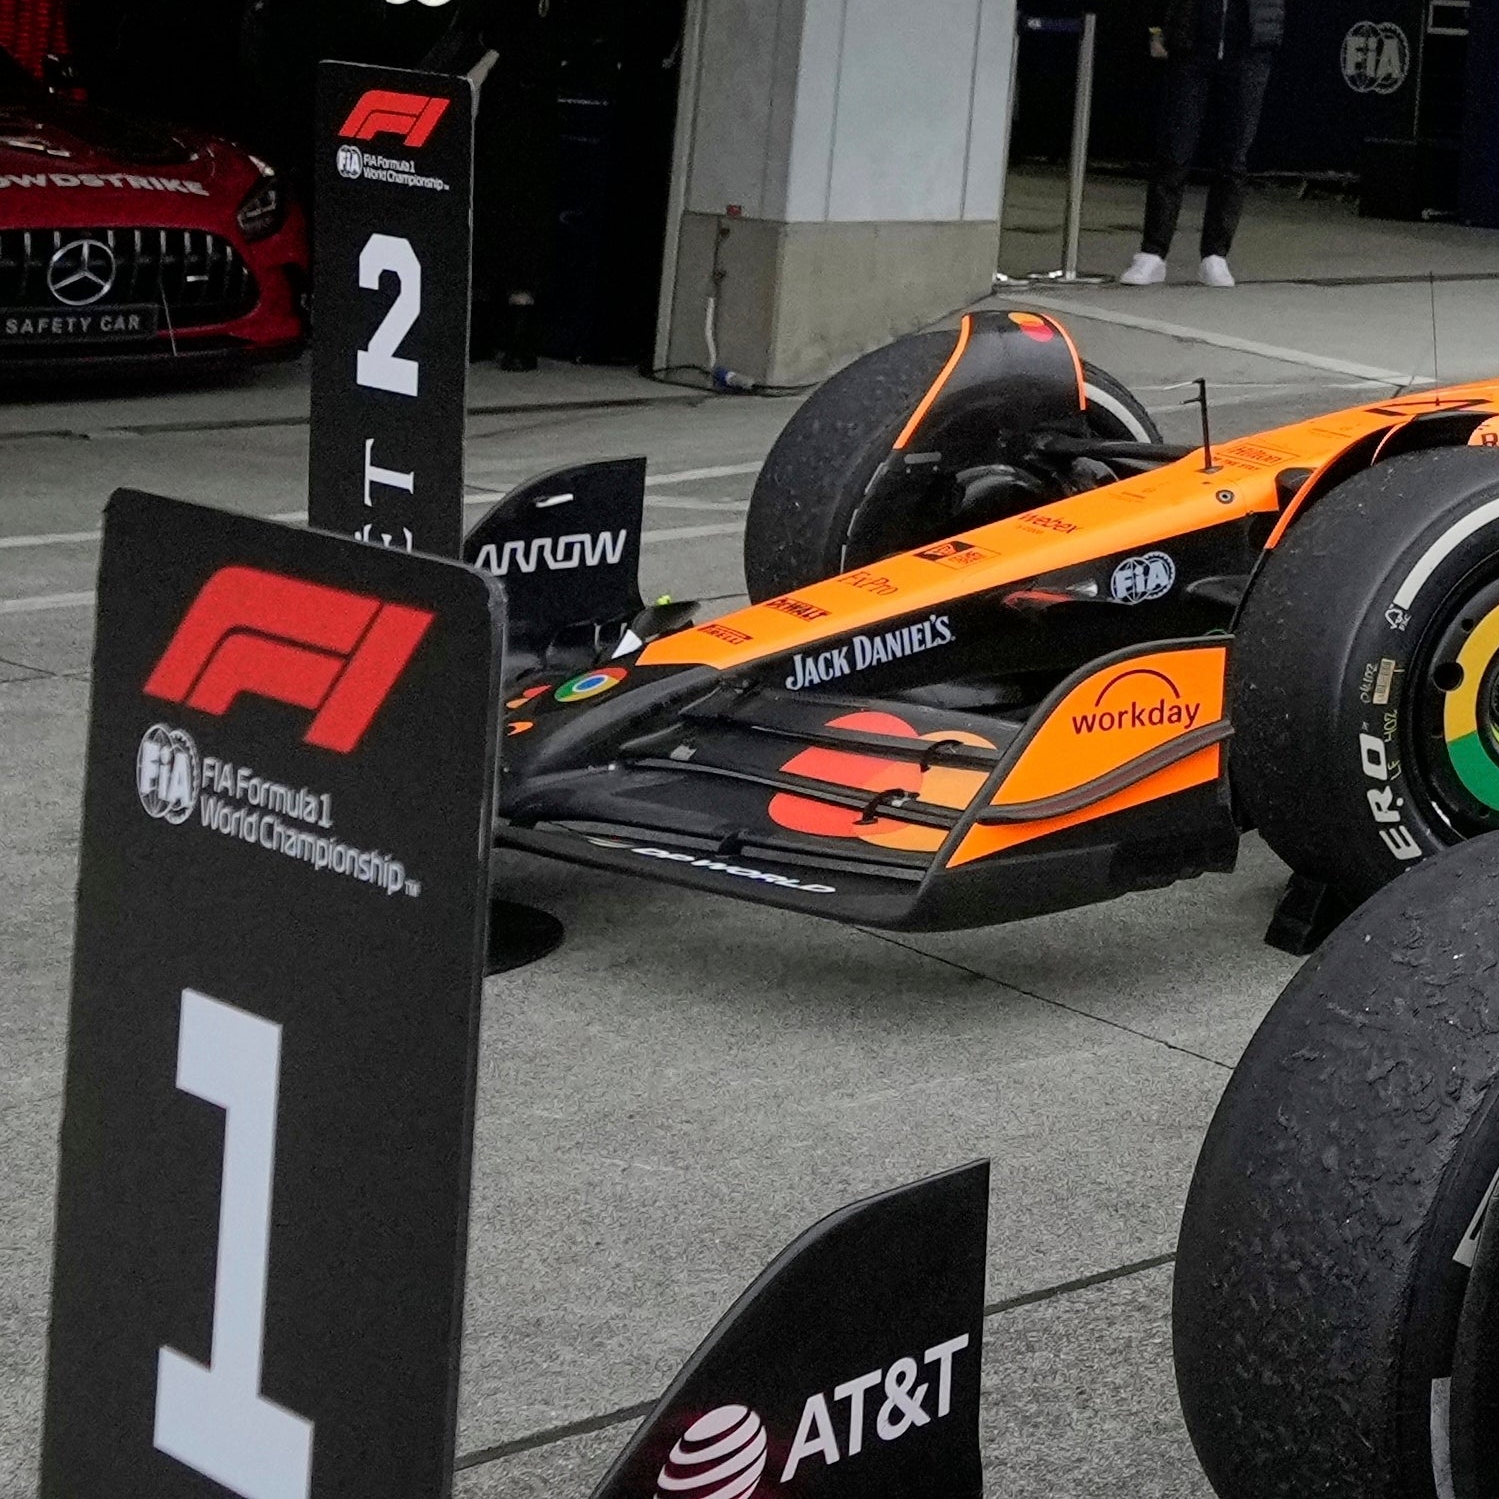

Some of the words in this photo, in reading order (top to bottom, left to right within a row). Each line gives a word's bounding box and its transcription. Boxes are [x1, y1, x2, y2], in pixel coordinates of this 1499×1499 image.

[5, 317, 92, 335] SAFETY
[100, 314, 141, 331] CAR
[356, 232, 422, 397] 2
[697, 623, 754, 646] PIRELLI
[785, 645, 852, 692] JACK
[1072, 697, 1201, 737] workday
[202, 756, 236, 797] FIA
[236, 766, 320, 824] Formula
[319, 792, 334, 829] 1
[1358, 731, 1423, 861] ERO
[200, 794, 260, 844] World
[631, 846, 696, 863] DP
[693, 857, 837, 894] WORLD
[152, 987, 314, 1499] 1
[779, 1333, 970, 1483] AT&T
